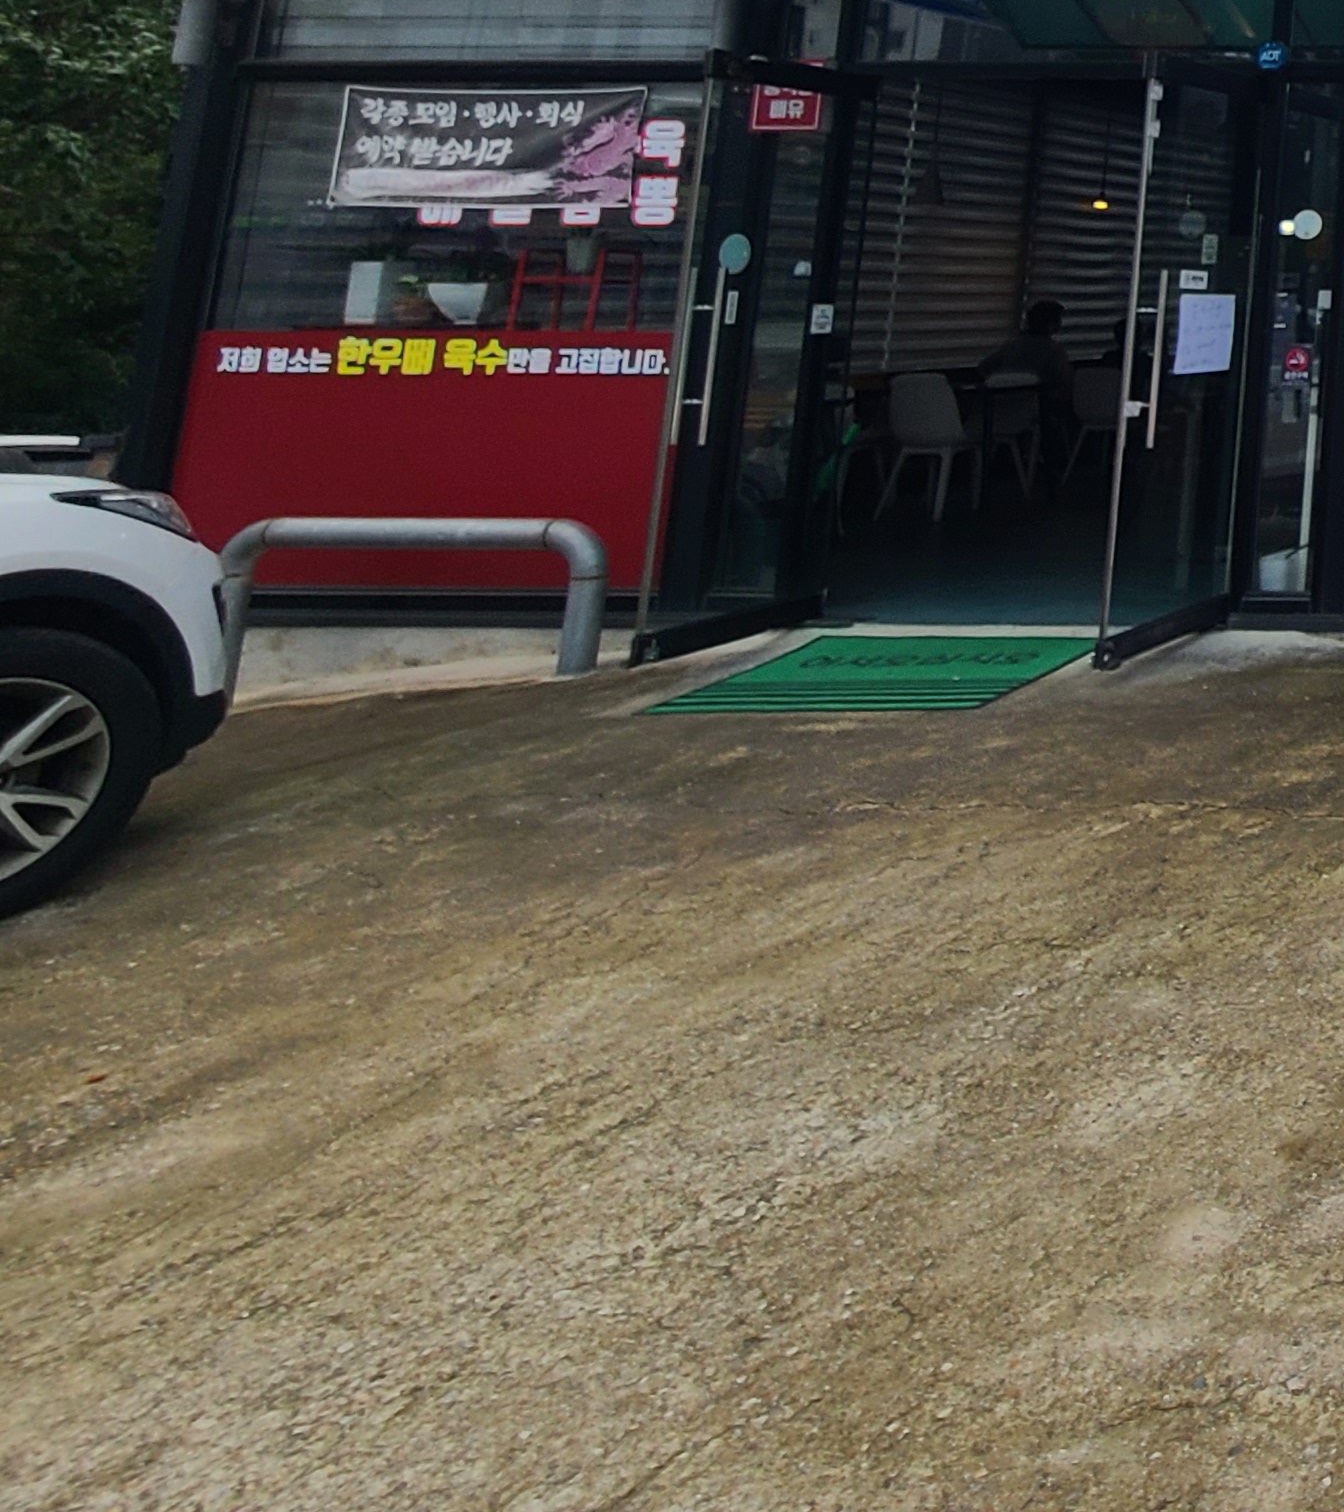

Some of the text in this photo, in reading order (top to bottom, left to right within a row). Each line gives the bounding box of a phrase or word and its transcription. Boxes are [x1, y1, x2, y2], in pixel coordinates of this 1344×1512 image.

[360, 98, 408, 128] 각종
[355, 135, 513, 167] 예약 받습니다
[217, 346, 262, 373] 저희
[267, 346, 332, 373] 업소는
[555, 347, 670, 375] 고집합니다.
